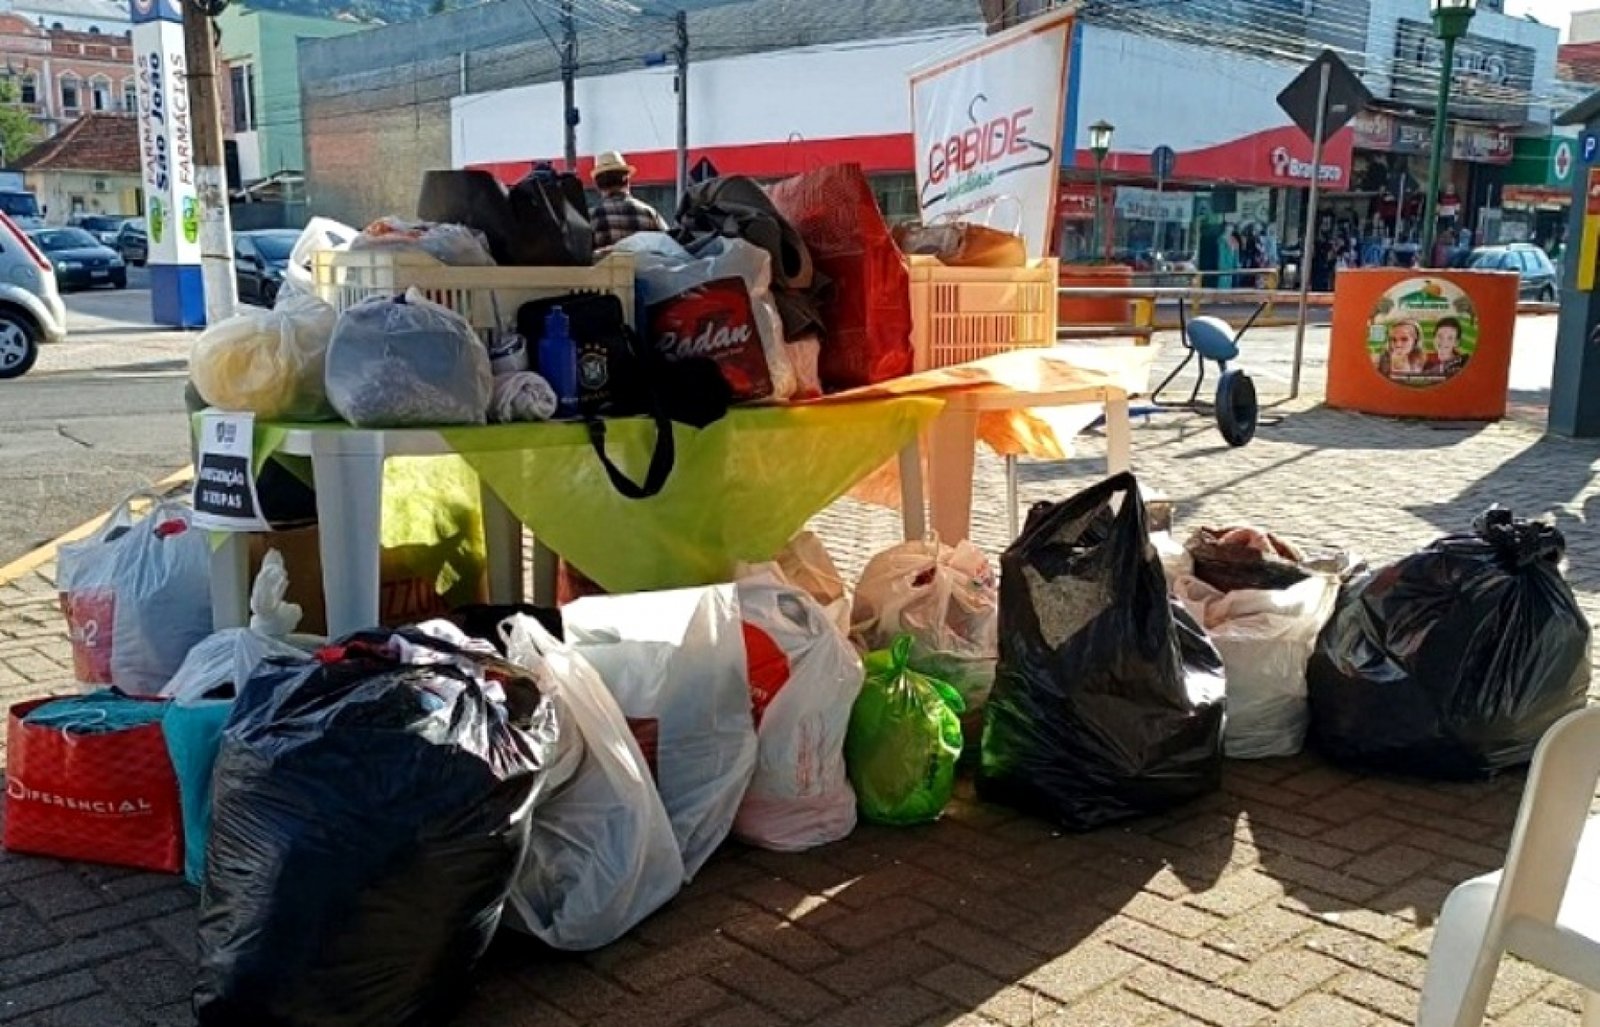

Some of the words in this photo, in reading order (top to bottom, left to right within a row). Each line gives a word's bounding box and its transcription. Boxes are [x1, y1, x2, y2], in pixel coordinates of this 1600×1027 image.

[149, 52, 164, 126] João
[154, 134, 169, 192] São
[7, 777, 153, 813] DIFERENCIAL
